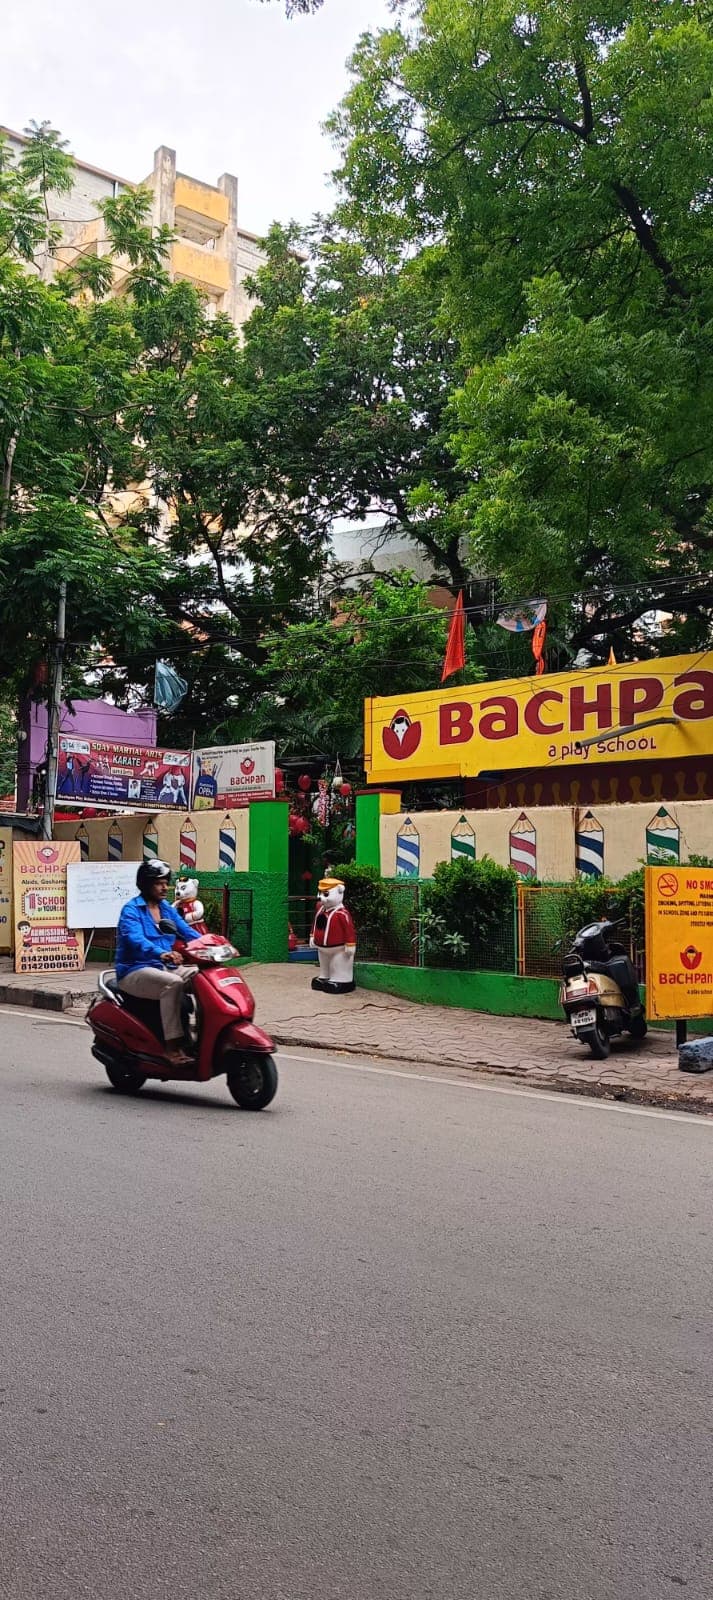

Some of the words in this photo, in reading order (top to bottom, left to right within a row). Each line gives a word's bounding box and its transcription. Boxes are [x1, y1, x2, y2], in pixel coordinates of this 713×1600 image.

[113, 744, 142, 756] MARTIAL
[145, 750, 162, 758] ARTS
[548, 745, 556, 757] a
[113, 755, 141, 767] KARATE
[686, 880, 697, 889] NO
[21, 962, 79, 970] 8142000661
